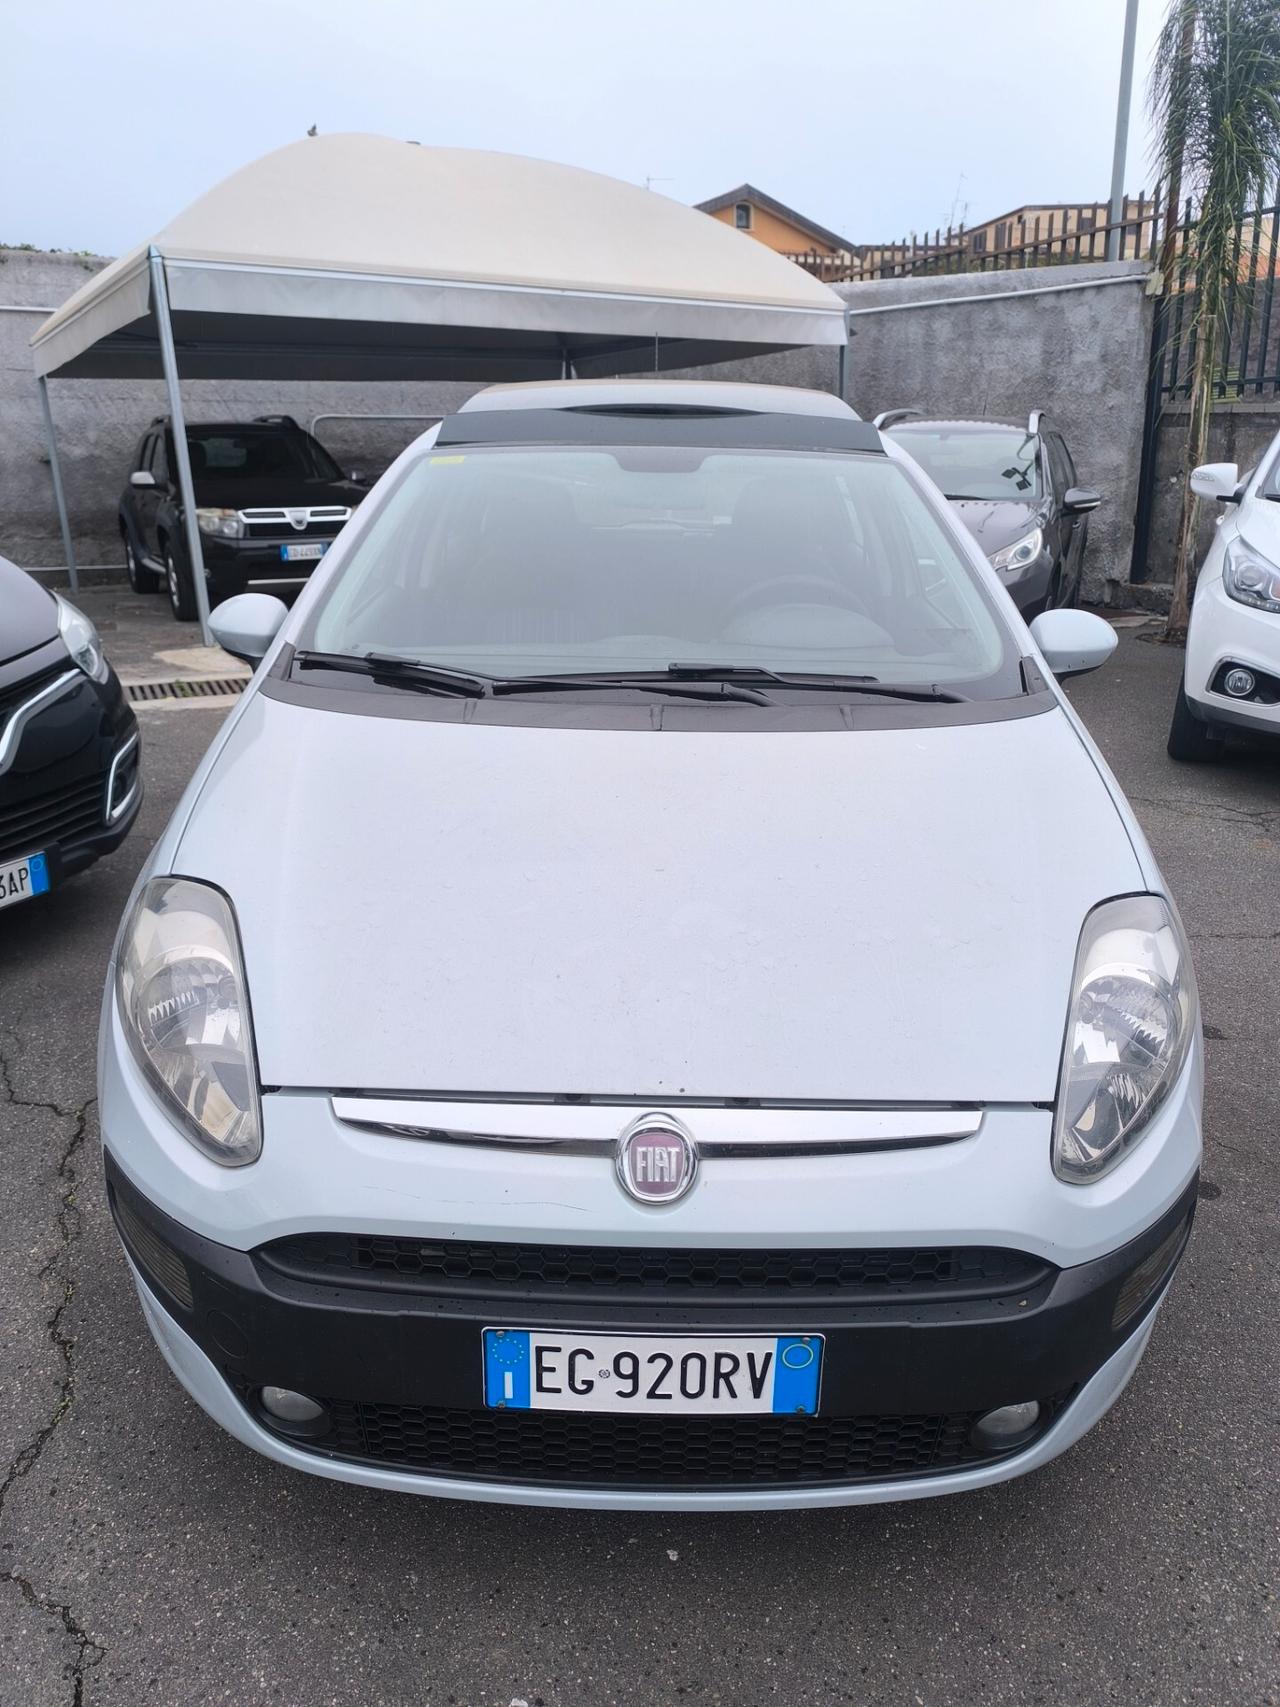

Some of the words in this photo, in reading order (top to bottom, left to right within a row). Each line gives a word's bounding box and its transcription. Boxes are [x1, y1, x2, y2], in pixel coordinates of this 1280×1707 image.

[636, 1146, 680, 1182] FIAT
[535, 1345, 594, 1395] EG
[612, 1351, 773, 1399] 920RV
